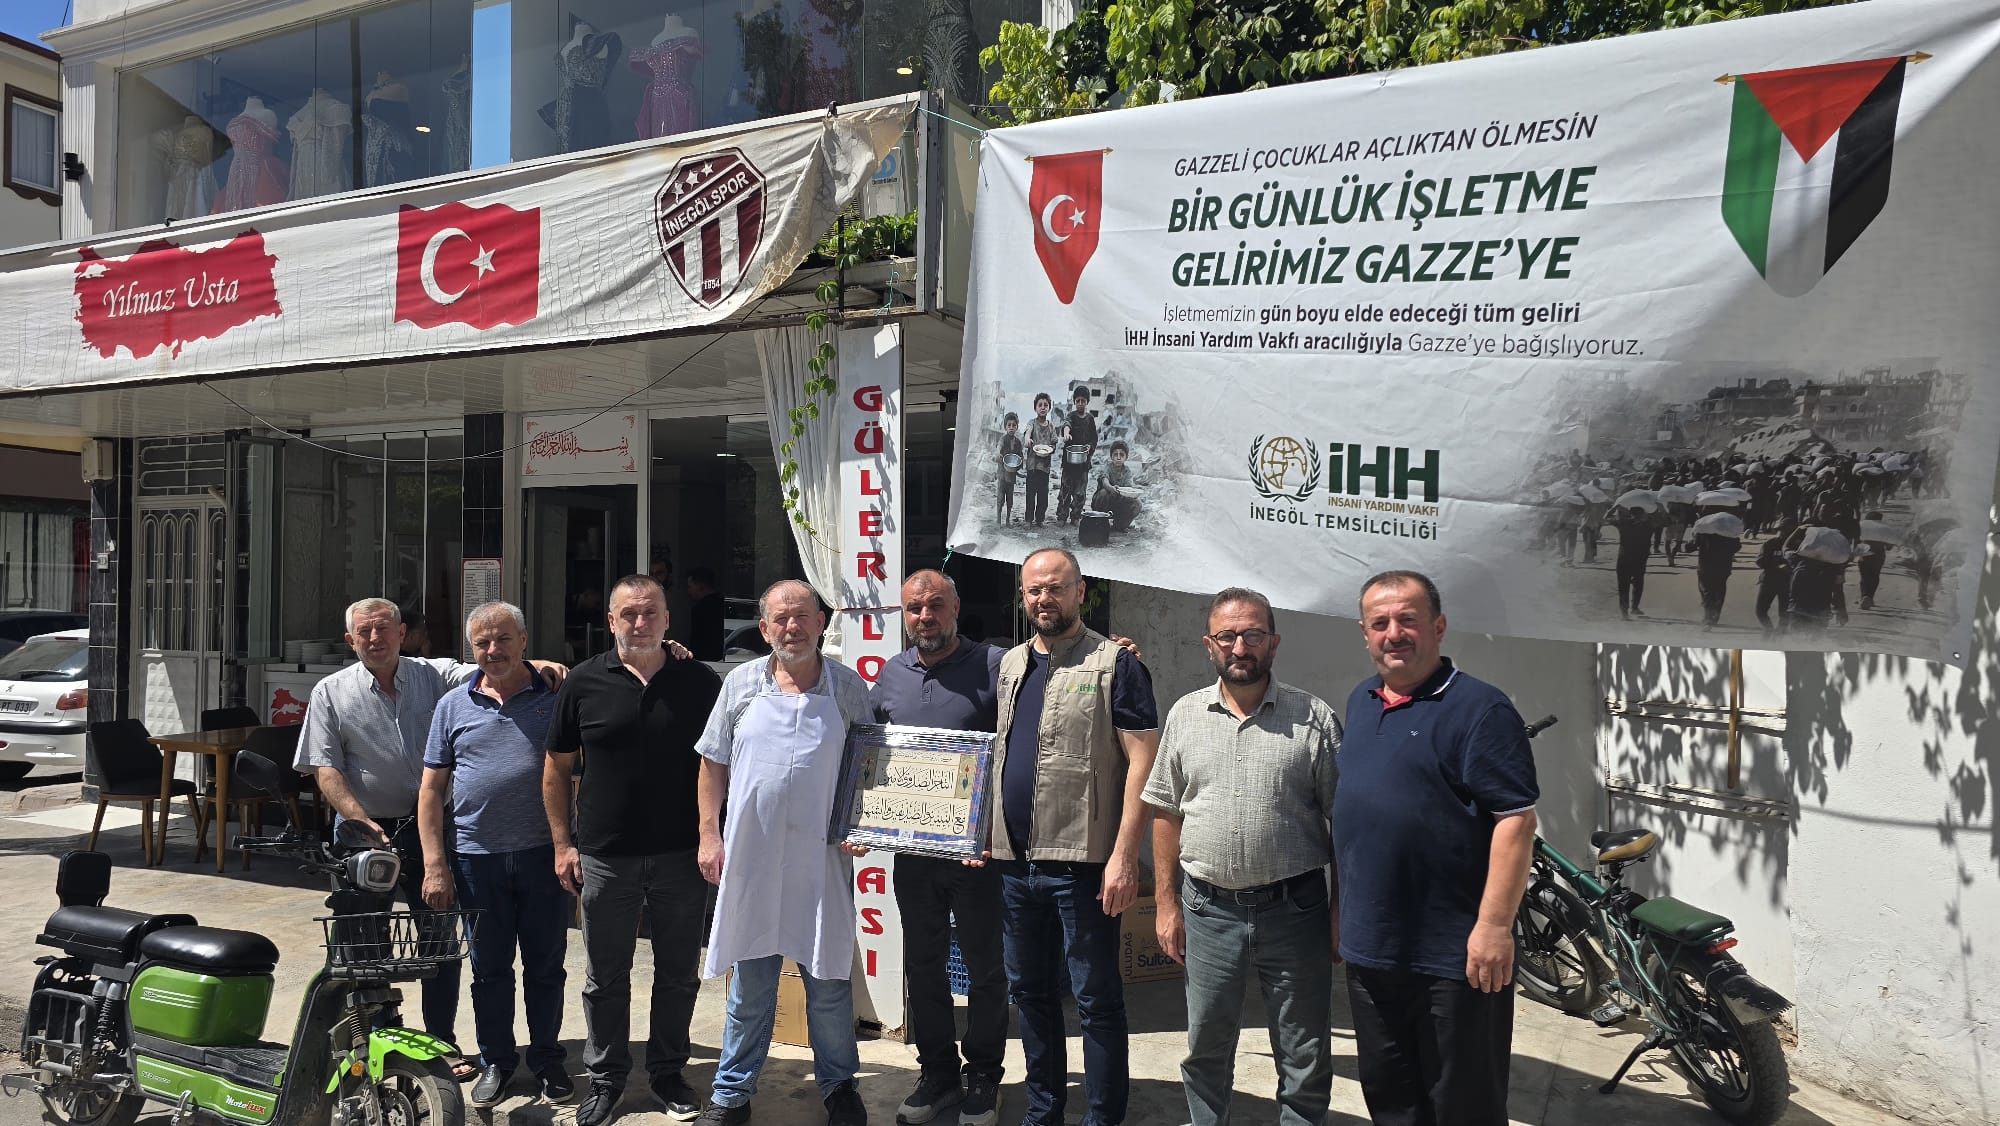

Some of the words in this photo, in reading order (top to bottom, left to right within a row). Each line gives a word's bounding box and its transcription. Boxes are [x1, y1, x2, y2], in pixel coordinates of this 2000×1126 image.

[1174, 147, 1250, 177] GAZZELİ
[1253, 140, 1360, 173] ÇOCUKLAR
[1363, 127, 1477, 161] AÇLIKTAN
[1482, 111, 1599, 148] ÖLMESİN
[664, 171, 750, 237] İNEGÖLSPOR
[1167, 186, 1223, 233] BİR
[1228, 174, 1394, 230] GÜNLÜK
[1394, 165, 1598, 231] İŞLETME
[703, 279, 721, 290] 1954
[1172, 236, 1351, 287] GELİRİMİZ
[1355, 236, 1580, 284] GAZZE’YE
[103, 281, 177, 318] Yılmaz
[183, 271, 240, 308] Usta
[1163, 302, 1256, 325] İşletmemizin
[1260, 304, 1291, 325] gün
[1296, 304, 1339, 325] boyu
[1344, 303, 1384, 323] elde
[1389, 302, 1468, 326] edeceği
[1474, 303, 1515, 323] tüm
[1521, 302, 1581, 326] geliri
[1124, 327, 1149, 346] İHH
[1153, 328, 1196, 347] İnsani
[1200, 331, 1253, 349] Yardım
[1258, 331, 1299, 350] Vakfı
[1303, 332, 1402, 355] aracılığıyla
[1408, 332, 1496, 357] Gazze’ye
[1502, 333, 1644, 358] bağışlıyoruz.
[853, 385, 888, 581] GÜLER
[1250, 502, 1309, 526] İNEGÖL
[1315, 513, 1437, 540] TEMSİLCİLİĞİ
[1362, 499, 1405, 514] YARDIM
[1407, 503, 1439, 517] VAKFI
[1123, 932, 1133, 977] ULUDAĞ
